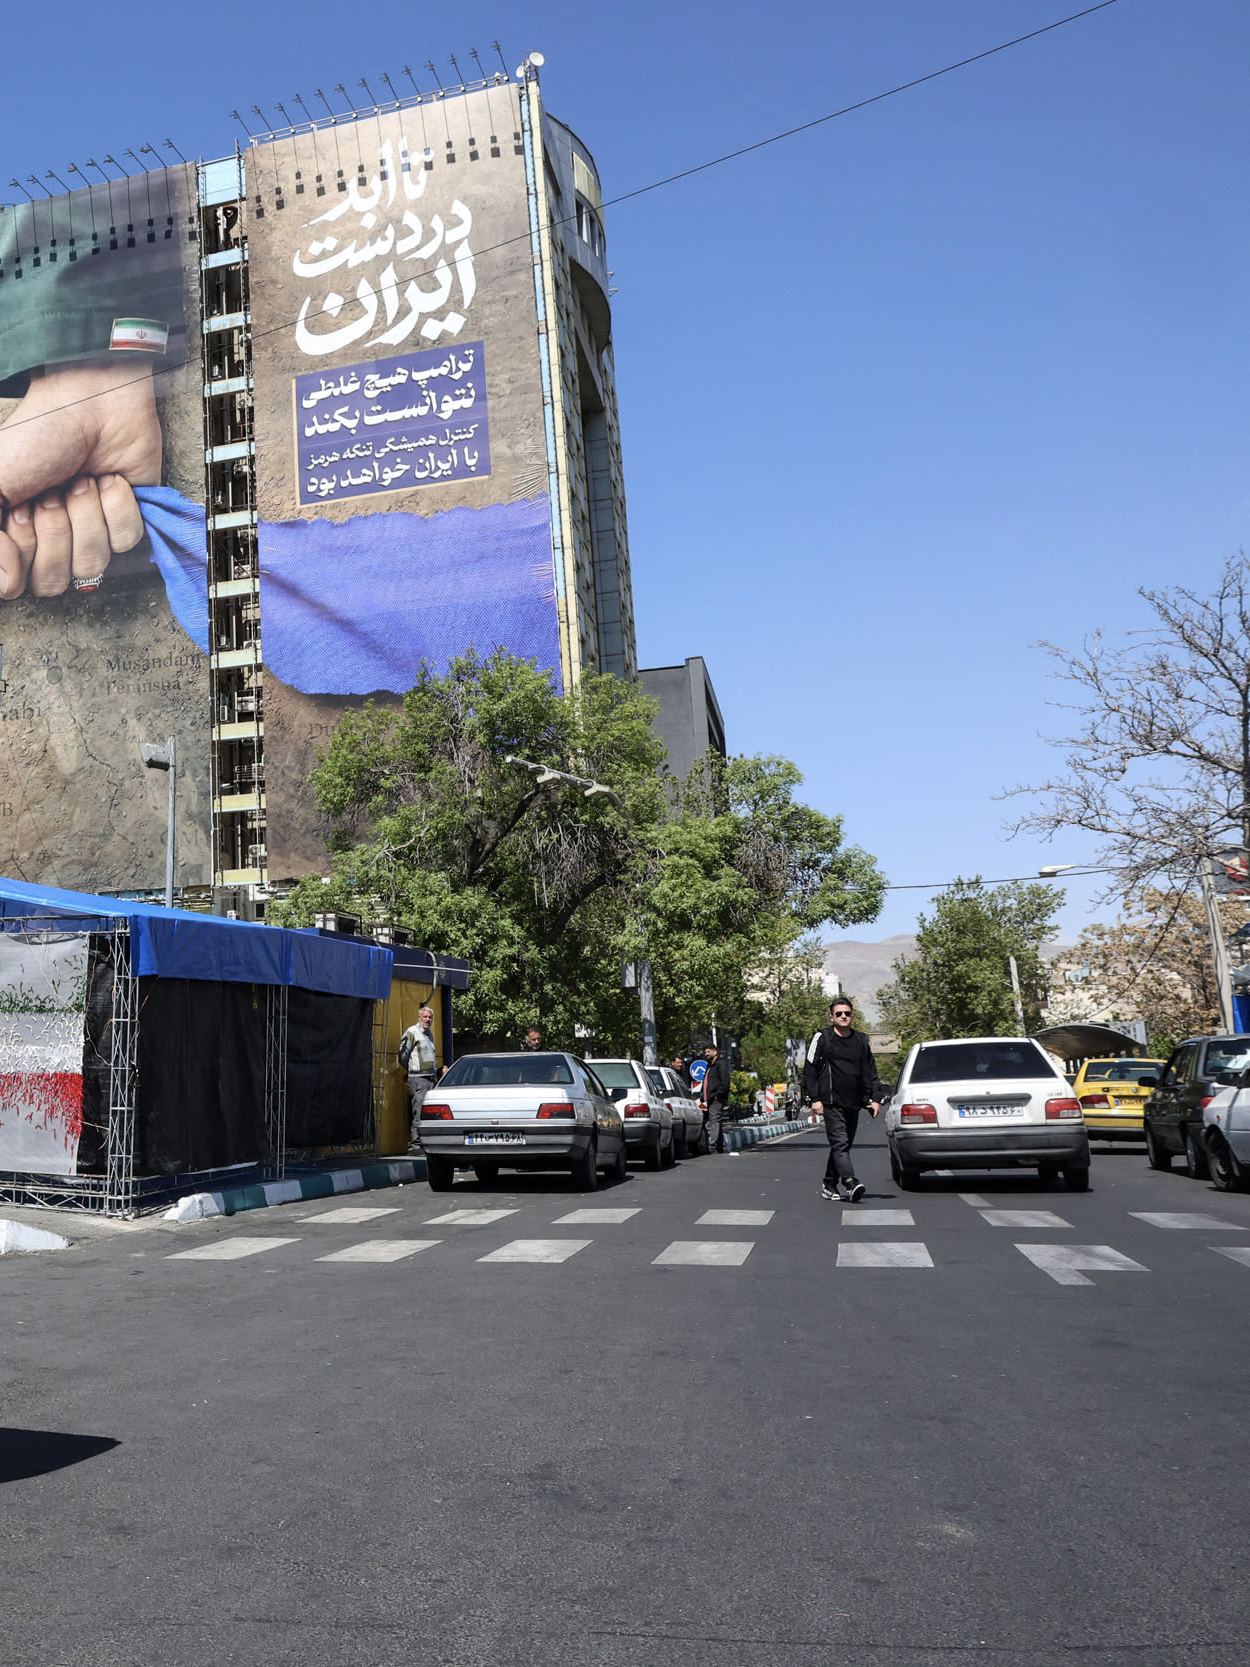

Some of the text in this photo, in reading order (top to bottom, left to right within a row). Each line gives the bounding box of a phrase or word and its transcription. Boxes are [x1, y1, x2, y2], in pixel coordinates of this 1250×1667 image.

[301, 135, 435, 231] تا ابد
[292, 200, 473, 278] در دست
[295, 239, 478, 356] ایران
[302, 348, 475, 409] ترامپ هیچ غلطی
[304, 381, 476, 438] نتوانست بکند
[438, 424, 479, 446] کنترل
[305, 450, 340, 471] هرمز
[306, 446, 479, 497] با ایران خواهد بود
